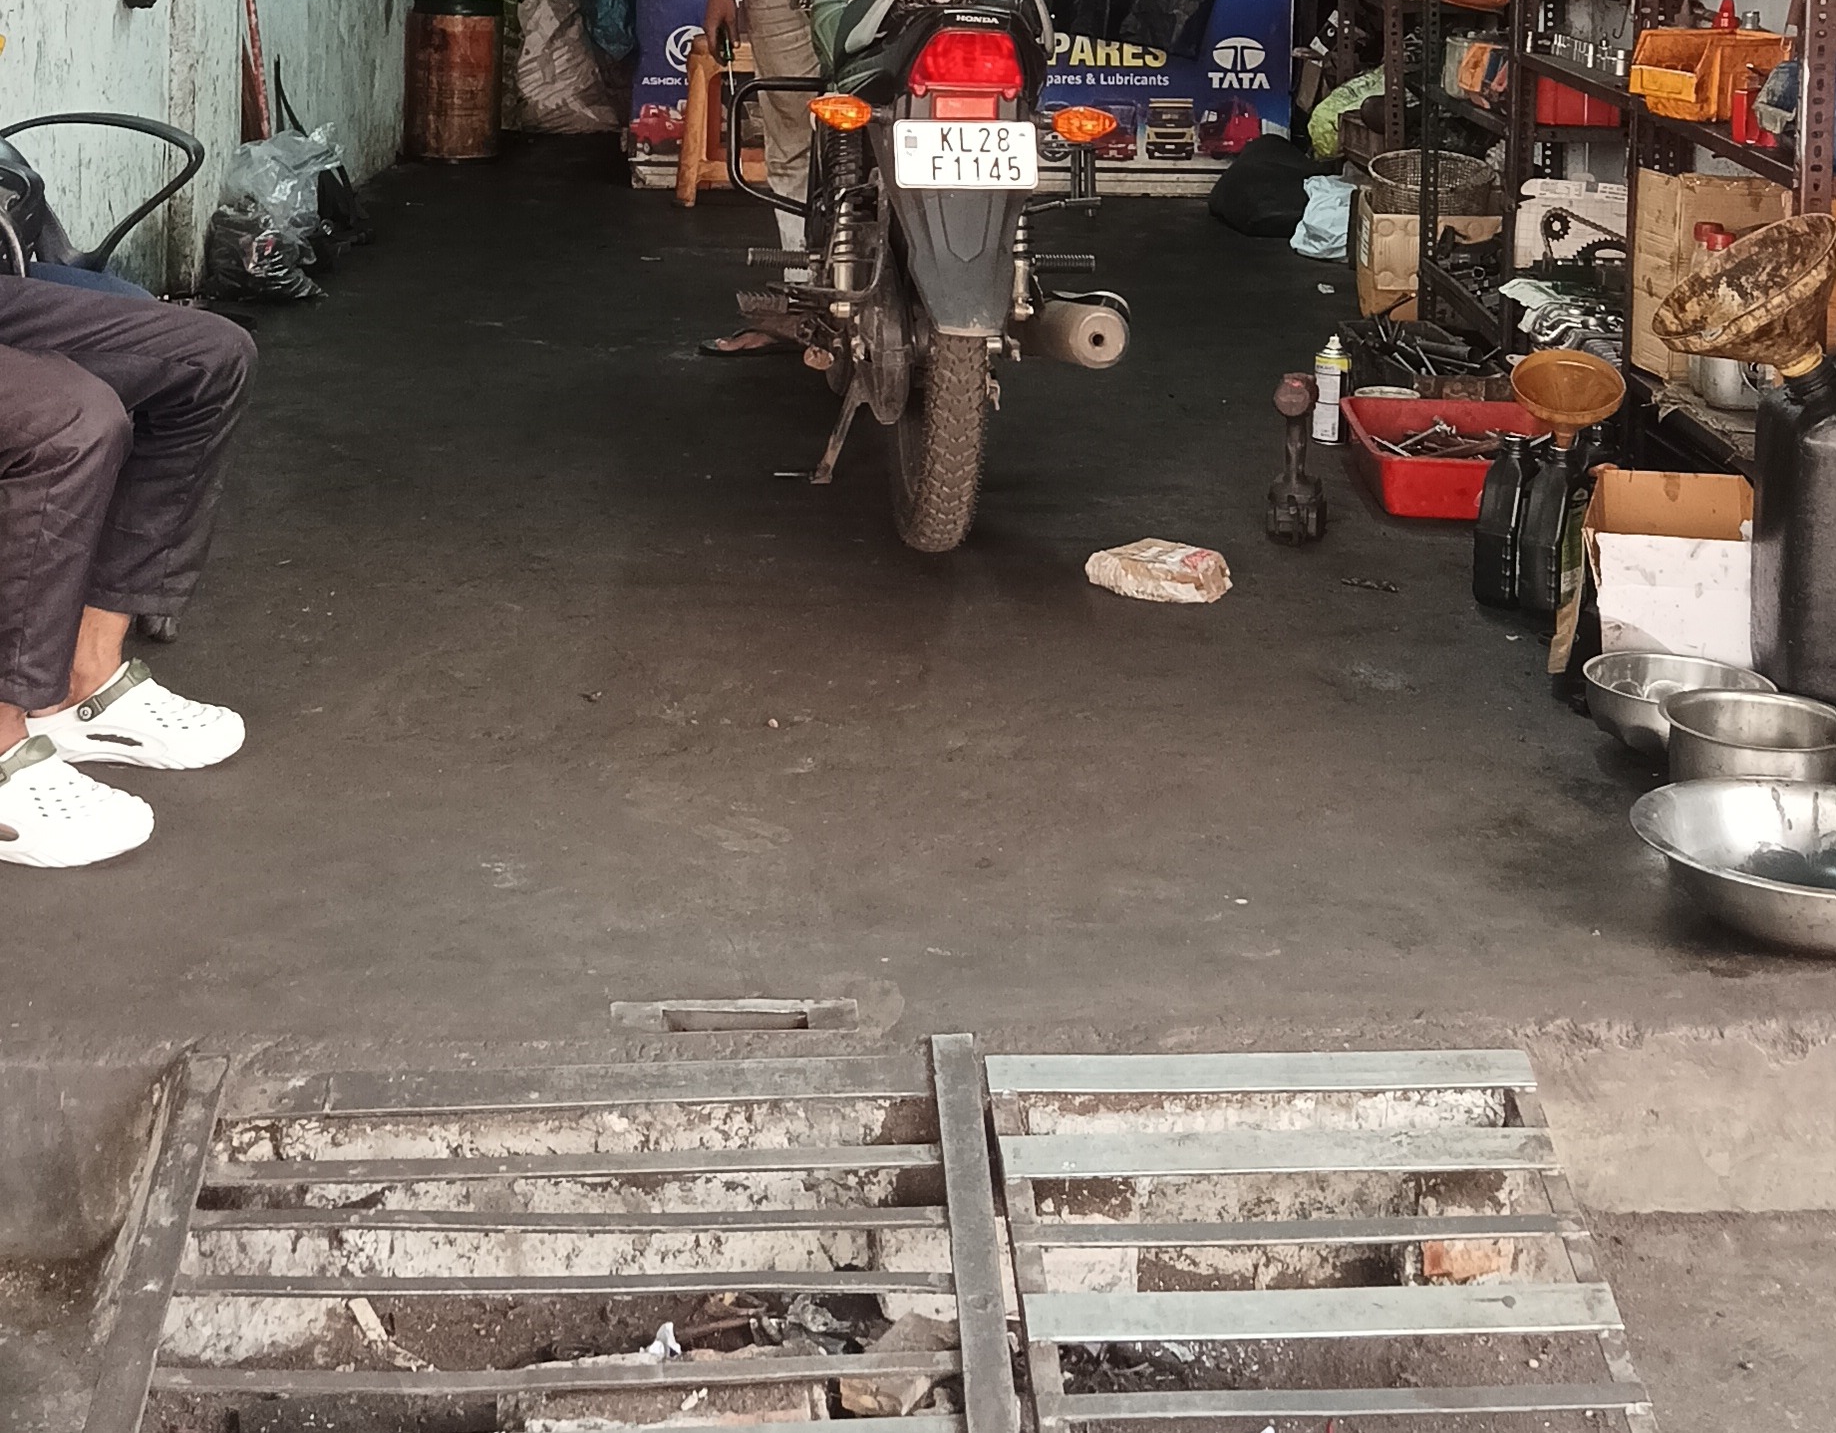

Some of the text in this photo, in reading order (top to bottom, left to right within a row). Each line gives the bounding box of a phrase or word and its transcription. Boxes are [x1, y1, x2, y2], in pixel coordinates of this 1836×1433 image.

[956, 15, 999, 25] HONDA
[1036, 32, 1167, 67] PARES
[641, 77, 682, 86] ASHOK
[1046, 73, 1170, 87] pares & Lubricants
[1208, 72, 1270, 89] TATA
[940, 127, 1010, 153] KL28
[932, 156, 1021, 181] F1145
